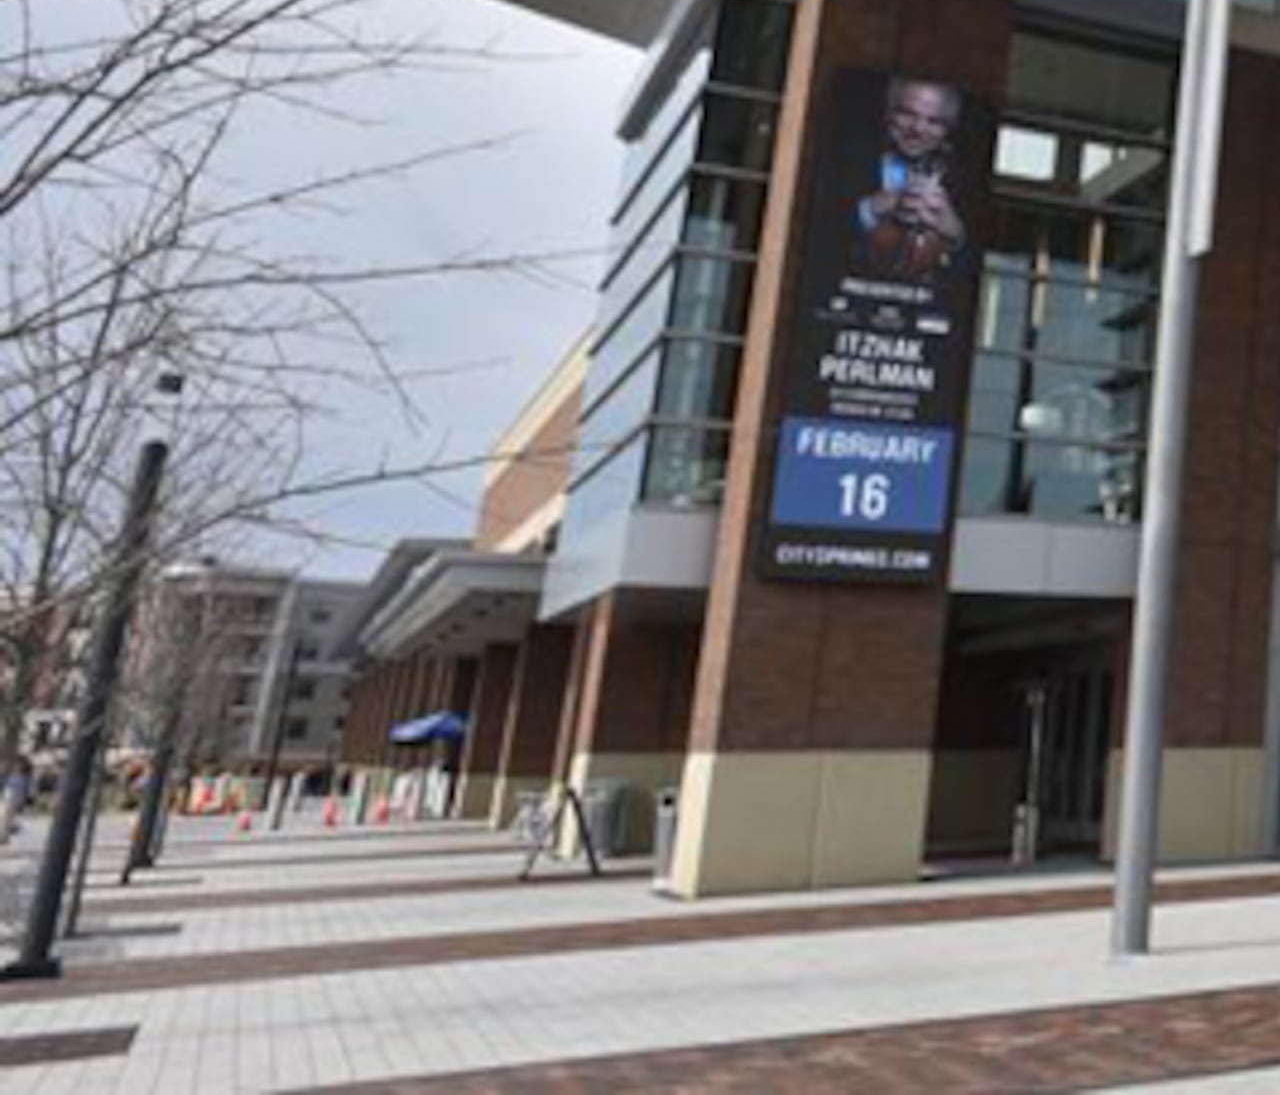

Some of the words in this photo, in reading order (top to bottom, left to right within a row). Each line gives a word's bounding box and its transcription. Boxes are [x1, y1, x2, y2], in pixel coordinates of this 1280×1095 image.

[835, 330, 924, 362] ITZHAK
[819, 354, 934, 391] PERLMAN
[797, 426, 936, 462] FEBRUARY
[838, 473, 890, 520] 16
